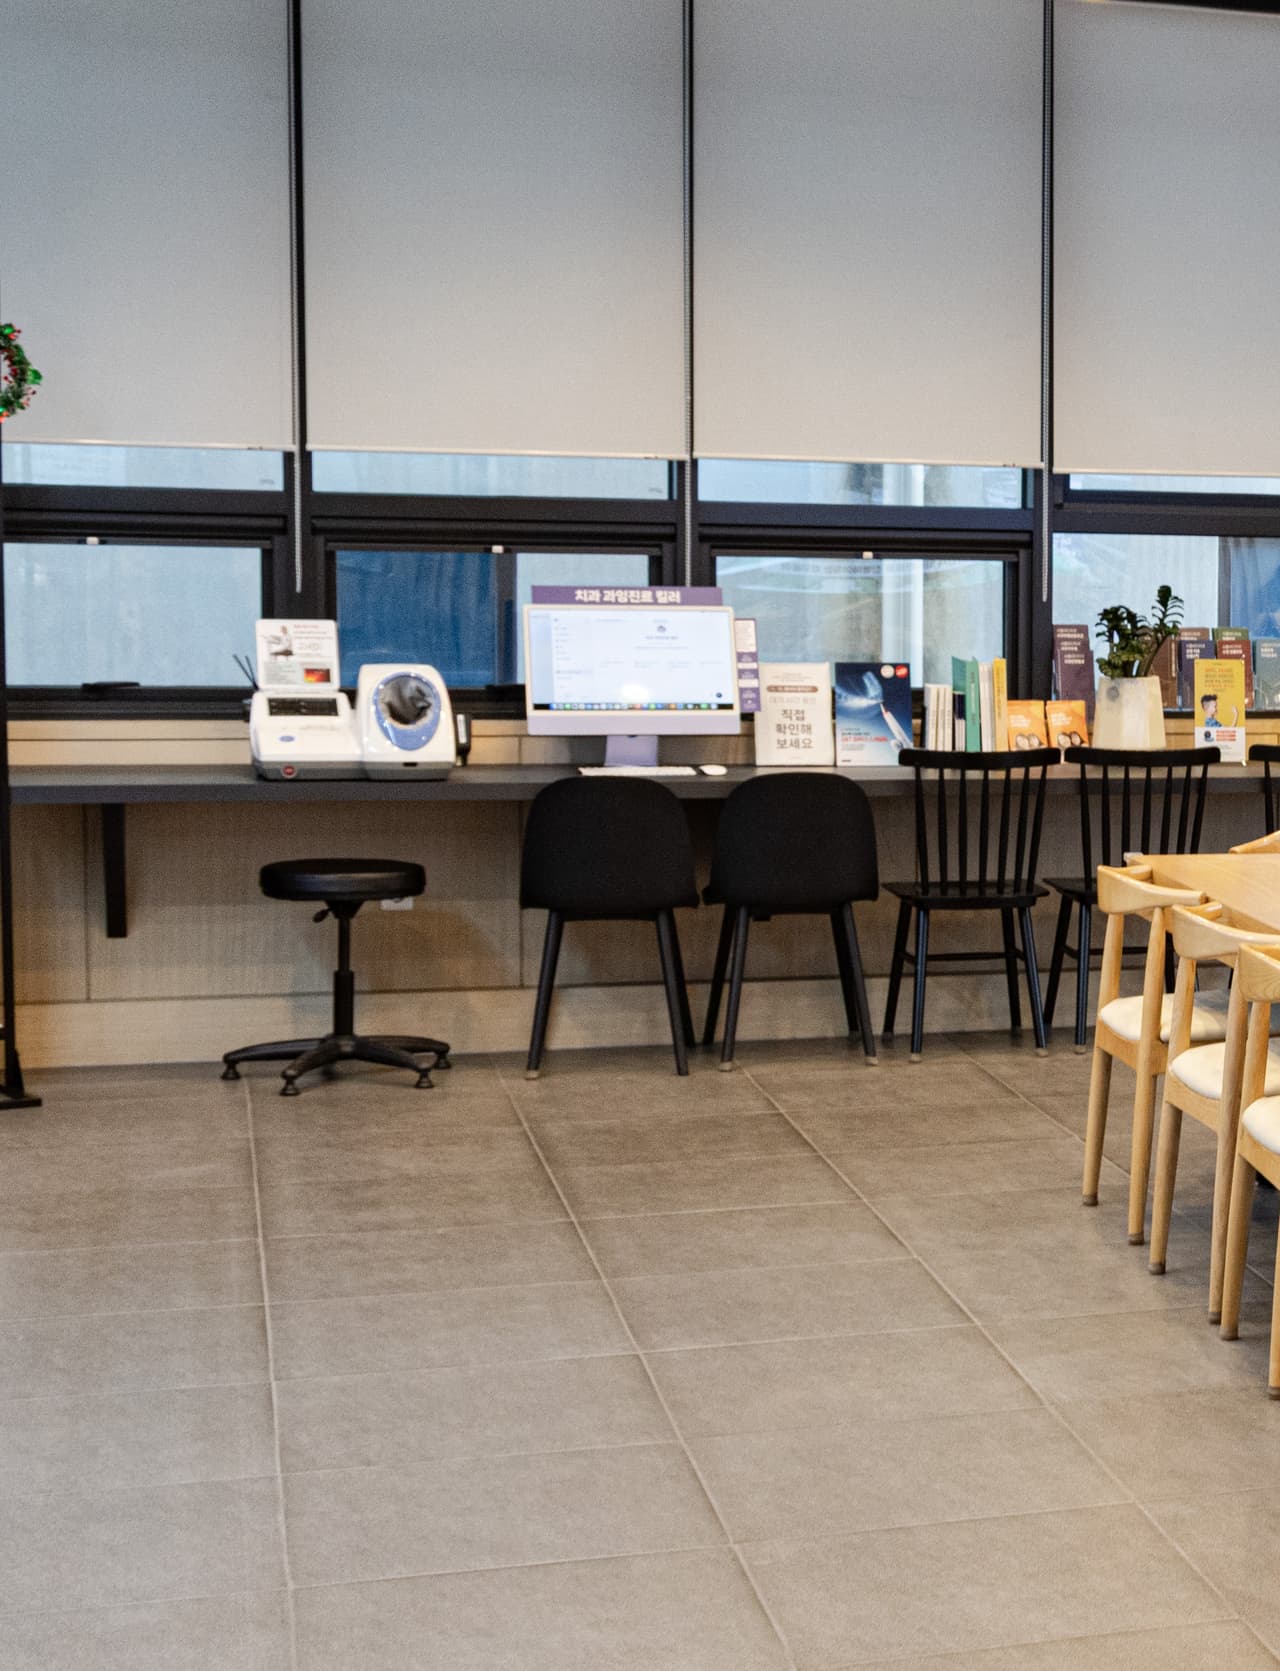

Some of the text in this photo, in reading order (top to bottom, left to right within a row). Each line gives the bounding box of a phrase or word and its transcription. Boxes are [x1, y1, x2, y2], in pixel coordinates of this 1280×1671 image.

[574, 589, 602, 603] 치과
[781, 709, 806, 721] 직접
[776, 723, 813, 736] 확인해
[776, 737, 814, 750] 보세요
